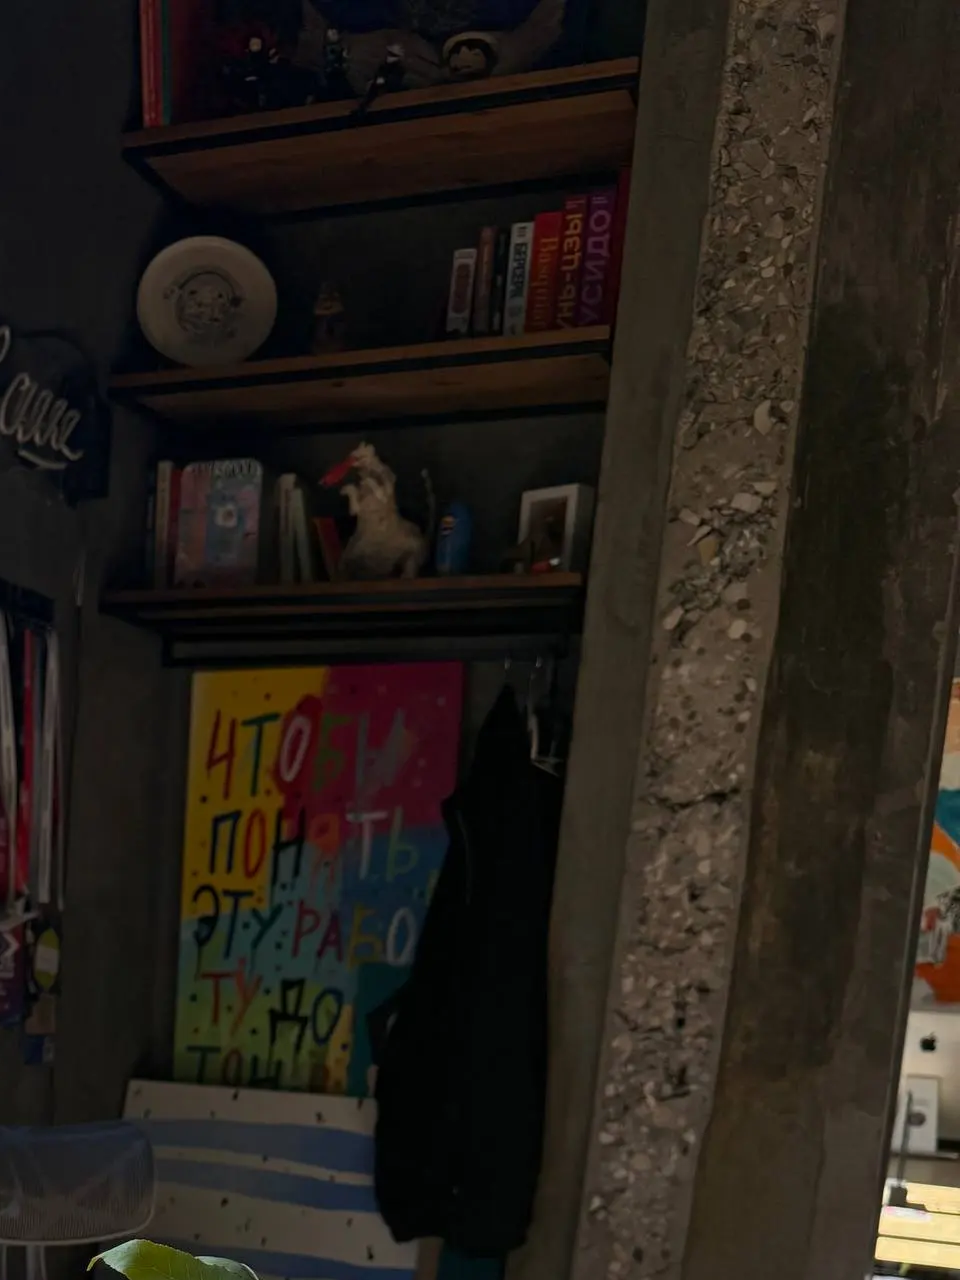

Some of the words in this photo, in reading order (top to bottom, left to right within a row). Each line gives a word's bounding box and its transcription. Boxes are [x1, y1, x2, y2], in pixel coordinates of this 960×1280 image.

[556, 212, 585, 329] УНЬ-ЦЗЫ
[577, 209, 613, 325] УСИДО
[205, 707, 411, 801] ЧТОБЫ
[209, 806, 421, 886] ПОНЯТЬ
[192, 884, 283, 960] ЭТУ
[291, 900, 417, 969] РАБО
[200, 958, 262, 1036] ТУ
[268, 978, 344, 1050] ДО
